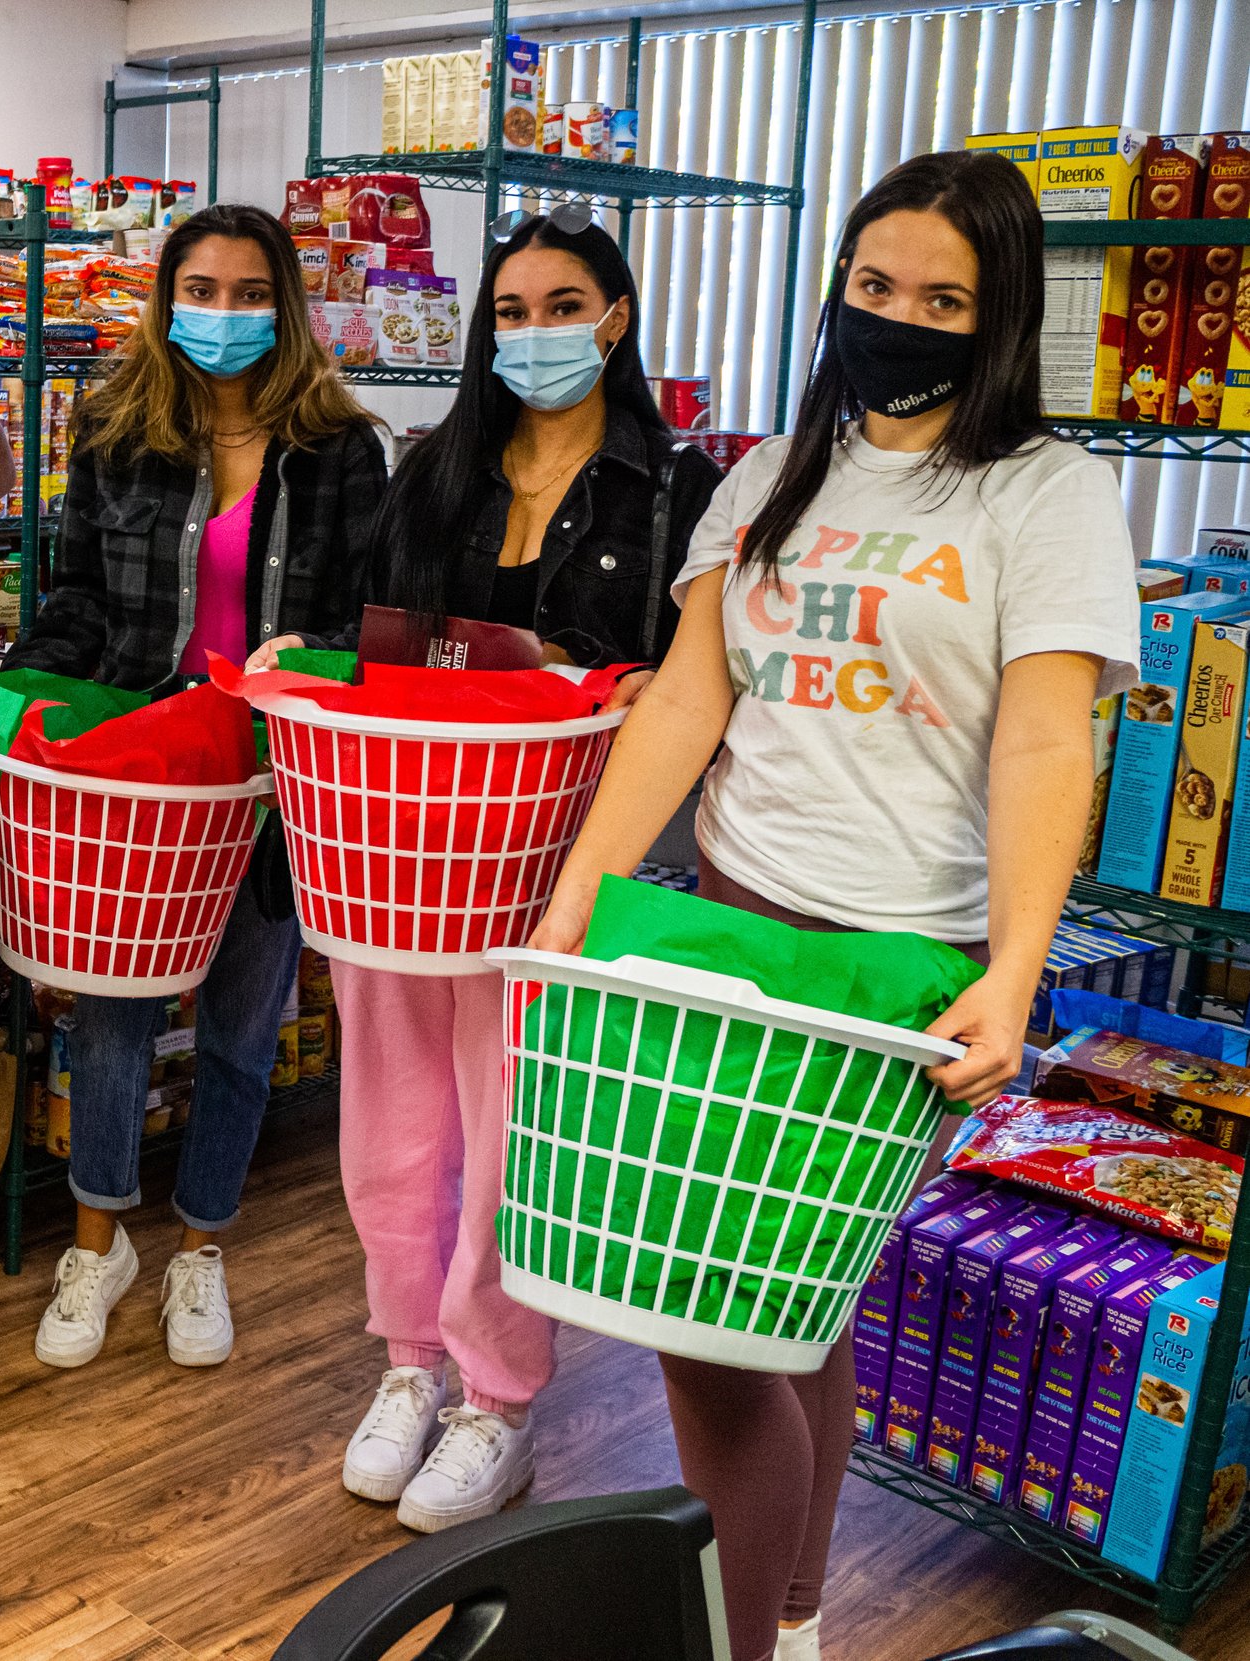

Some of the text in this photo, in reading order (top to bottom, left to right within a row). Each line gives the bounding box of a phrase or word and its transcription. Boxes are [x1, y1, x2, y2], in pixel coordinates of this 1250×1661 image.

[1052, 143, 1070, 155] BOXES
[1074, 142, 1092, 154] GREAT
[1094, 140, 1110, 153] VALUE
[1048, 164, 1105, 184] Cheerios
[290, 211, 319, 224] CHUNKY
[350, 318, 366, 327] CUP
[340, 326, 372, 338] NOODLES
[886, 392, 929, 413] alpha
[1209, 546, 1249, 560] CORN
[745, 580, 888, 646] CHI
[1140, 636, 1178, 655] Crisp
[1140, 652, 1173, 670] Rice
[1187, 664, 1213, 727] Cheerios
[1176, 839, 1206, 850] MADE WITH
[1184, 849, 1195, 864] 5
[1172, 872, 1201, 887] WHOLE
[1168, 883, 1200, 899] GRAINS
[1104, 1202, 1161, 1228] Mateys
[1152, 1332, 1194, 1361] Crisp
[1153, 1349, 1187, 1372] Rice
[993, 1364, 1020, 1379] SHE/HER
[988, 1377, 1021, 1395] THEY/THEM
[1045, 1382, 1072, 1398] SHE/HER
[1039, 1393, 1072, 1413] THEY/THEM
[1093, 1401, 1120, 1418] SHE/HER
[1086, 1413, 1121, 1434] THEY/THEM
